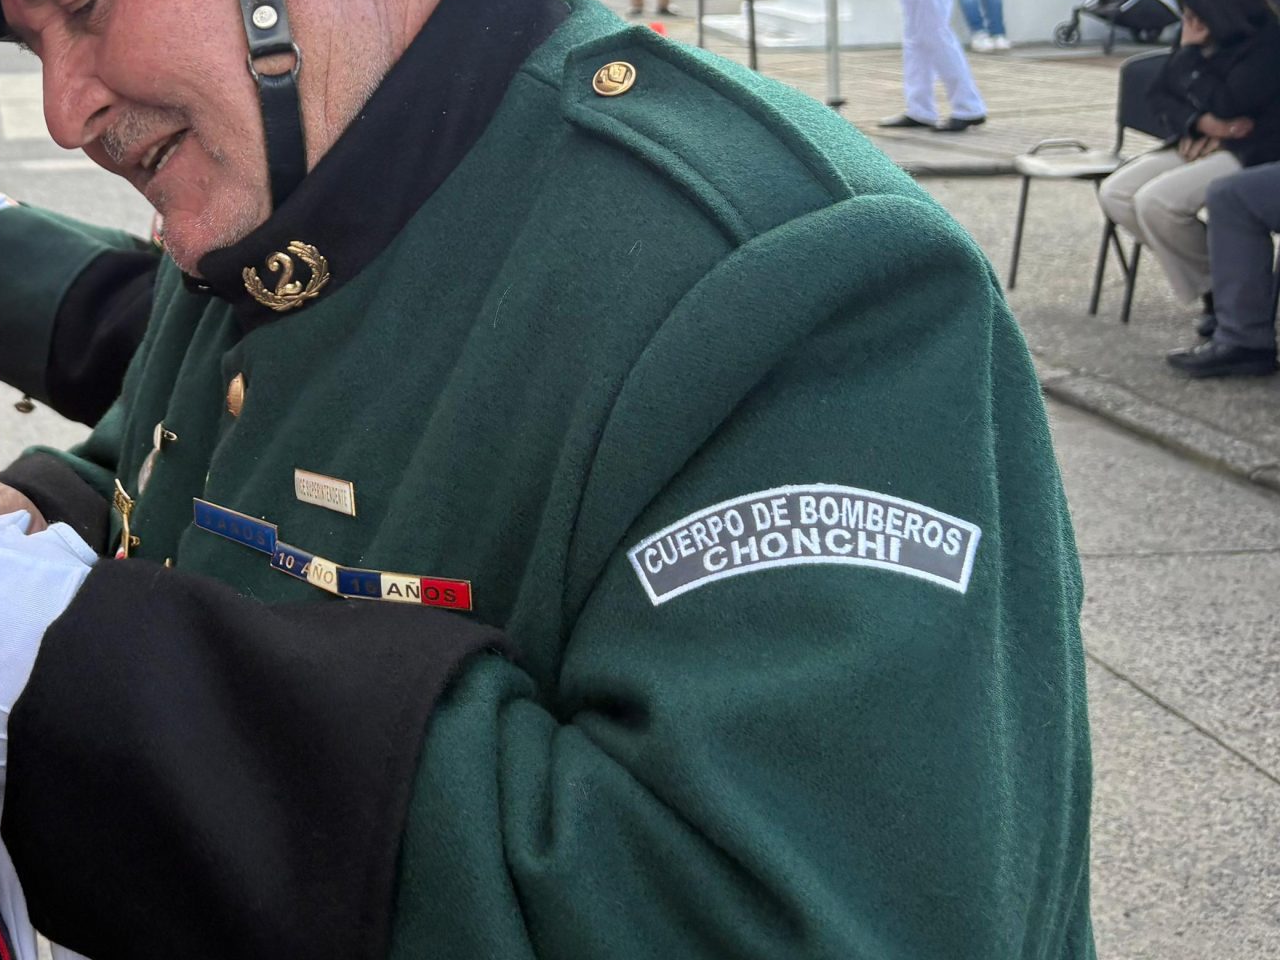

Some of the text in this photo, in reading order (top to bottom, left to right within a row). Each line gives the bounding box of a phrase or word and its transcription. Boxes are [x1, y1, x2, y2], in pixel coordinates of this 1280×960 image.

[265, 251, 303, 297] 2
[644, 495, 963, 575] CUERPO DE BOMBEROS
[702, 527, 903, 573] CHONCHI
[278, 552, 334, 585] 10 AÑO
[386, 581, 458, 603] AÑOS
